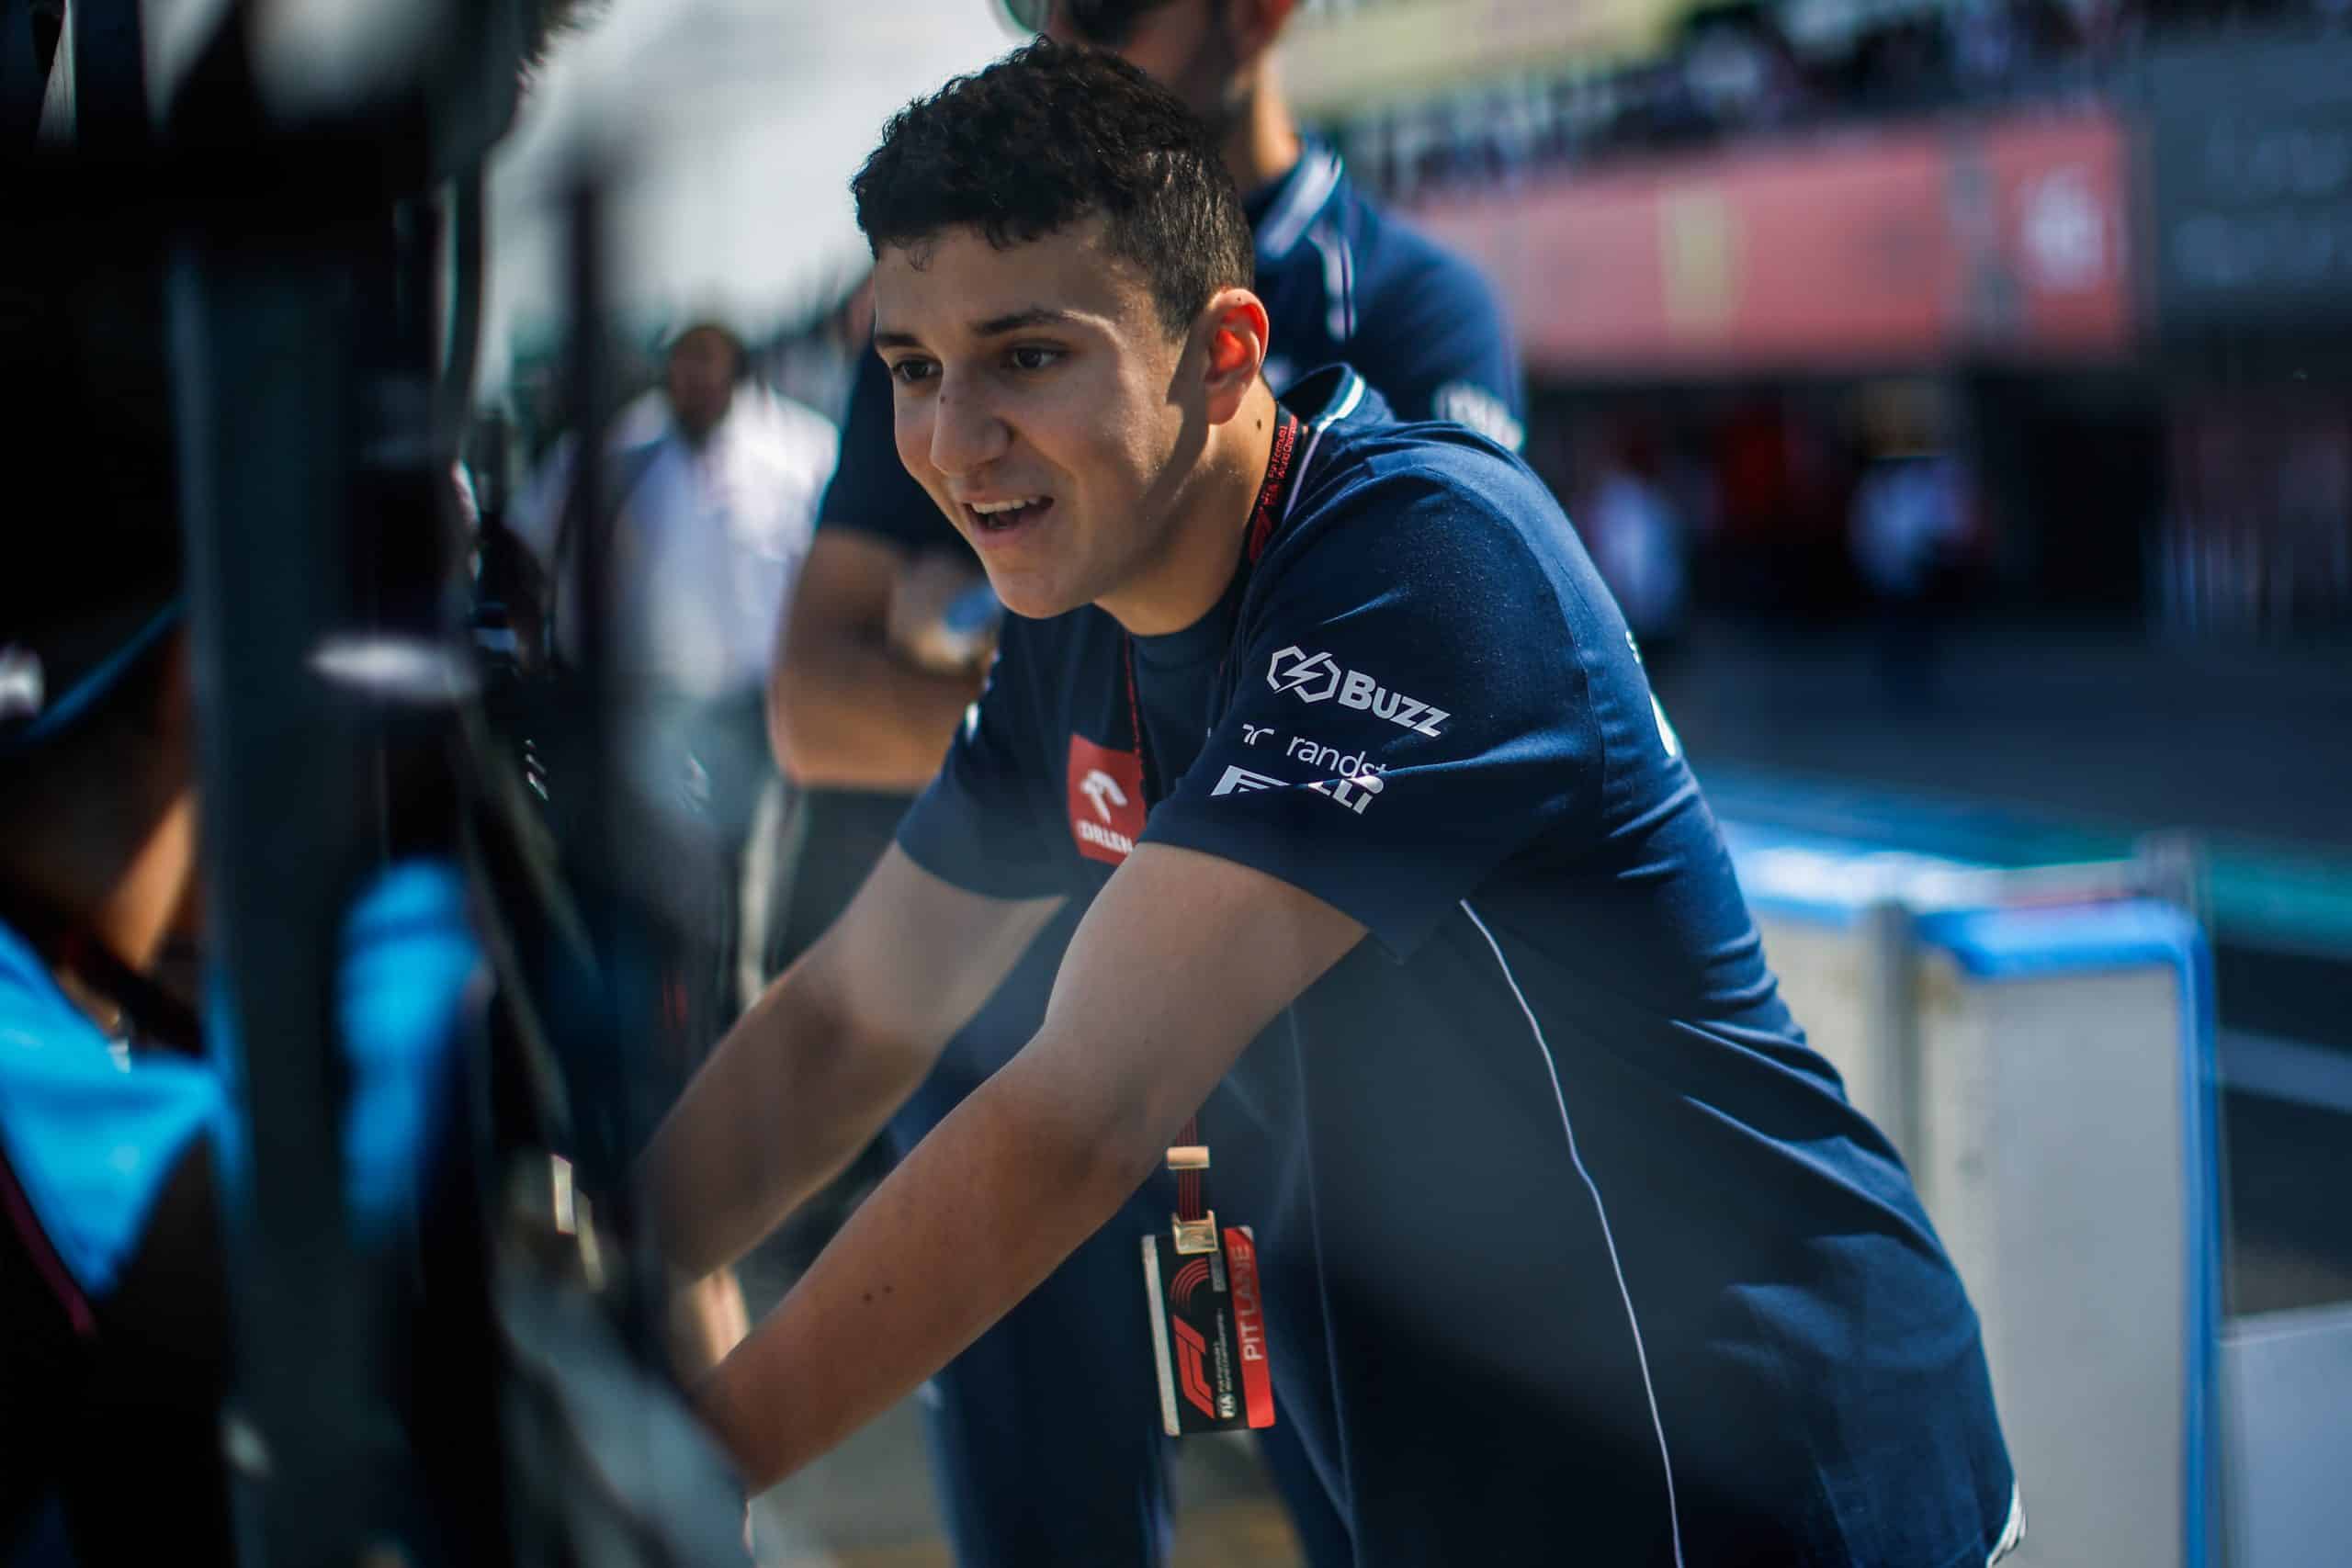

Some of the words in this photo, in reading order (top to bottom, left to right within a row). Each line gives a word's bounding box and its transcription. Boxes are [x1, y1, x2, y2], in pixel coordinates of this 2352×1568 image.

[1338, 670, 1452, 737] BUZZ
[1234, 1245, 1260, 1316] LANE
[1240, 1324, 1264, 1361] PIT
